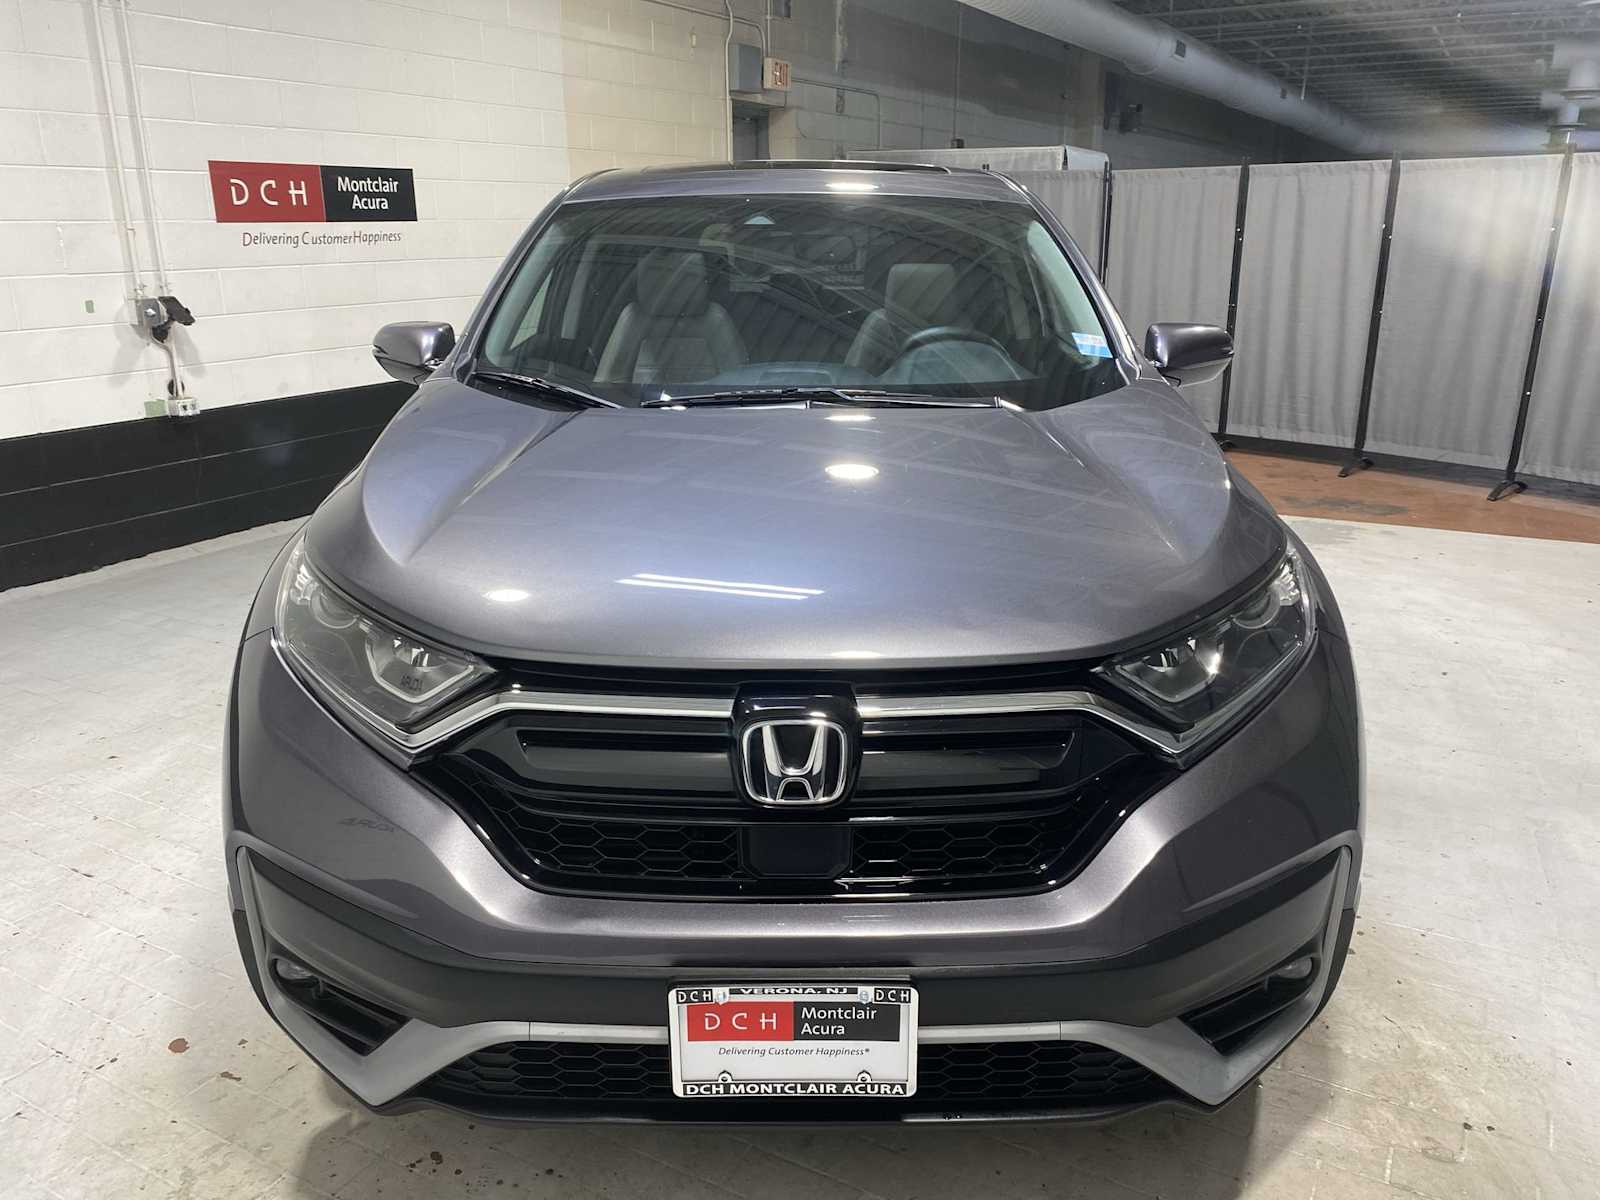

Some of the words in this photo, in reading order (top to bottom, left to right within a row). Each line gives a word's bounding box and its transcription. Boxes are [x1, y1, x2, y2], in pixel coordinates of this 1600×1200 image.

[337, 176, 399, 193] Montclair
[351, 194, 389, 210] Acura
[242, 232, 299, 248] Delivering
[301, 231, 352, 245] Customer
[353, 230, 401, 244] Happiness
[677, 990, 713, 1003] DCH
[826, 986, 848, 994] NJ
[875, 989, 910, 1002] DCH
[801, 1006, 877, 1020] Montclair
[801, 1022, 845, 1035] Acura
[718, 1047, 766, 1057] Delivering
[768, 1047, 814, 1056] Customer
[686, 1084, 724, 1095] DCH
[729, 1083, 837, 1095] MONTCLAIR
[842, 1083, 905, 1095] ACURA
